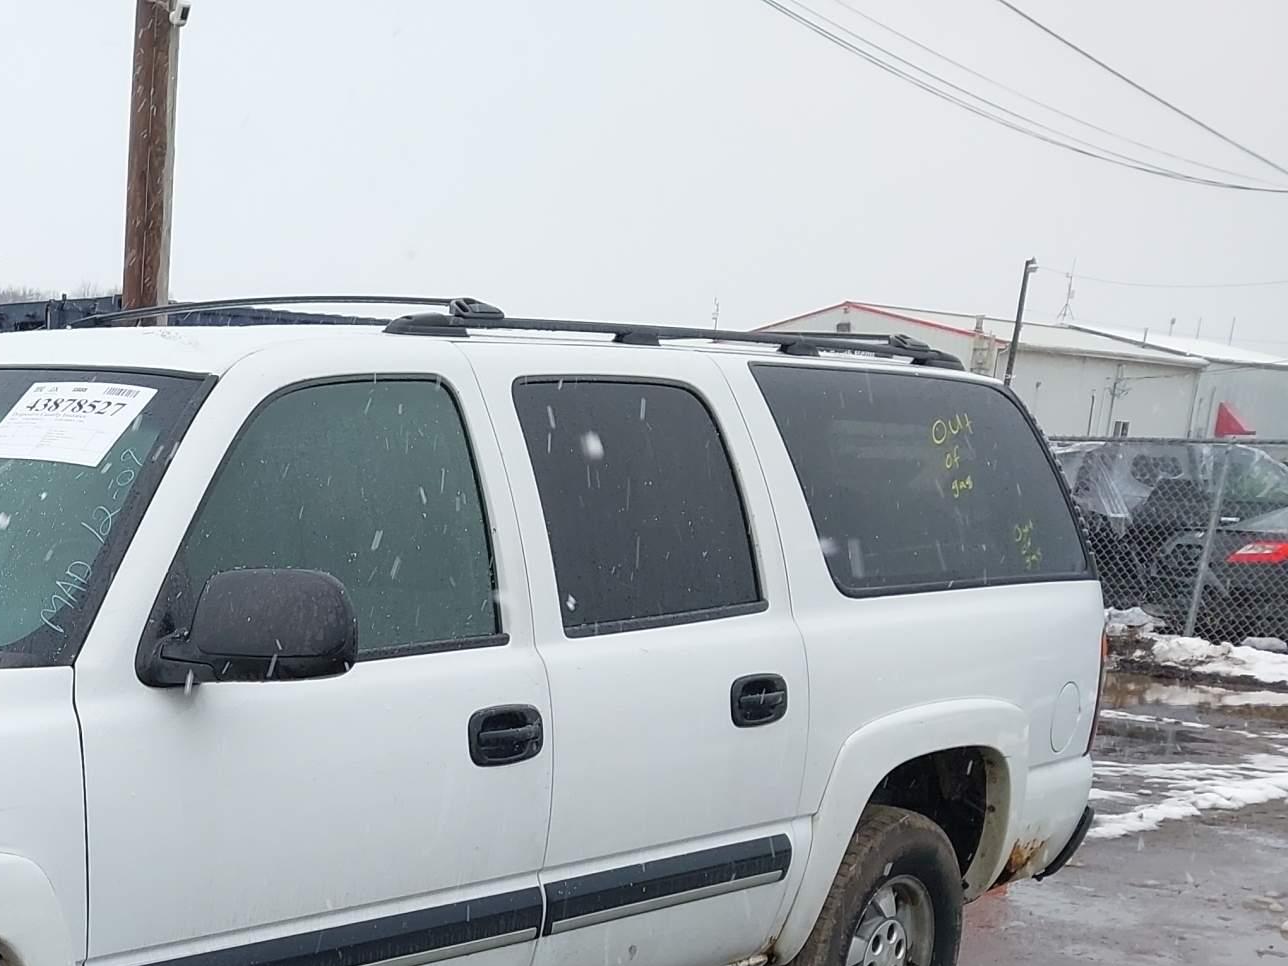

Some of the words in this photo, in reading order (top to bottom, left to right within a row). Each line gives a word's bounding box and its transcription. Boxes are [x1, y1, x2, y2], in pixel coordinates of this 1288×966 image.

[26, 398, 128, 417] 43878527
[945, 445, 962, 469] of
[40, 560, 93, 633] MAD
